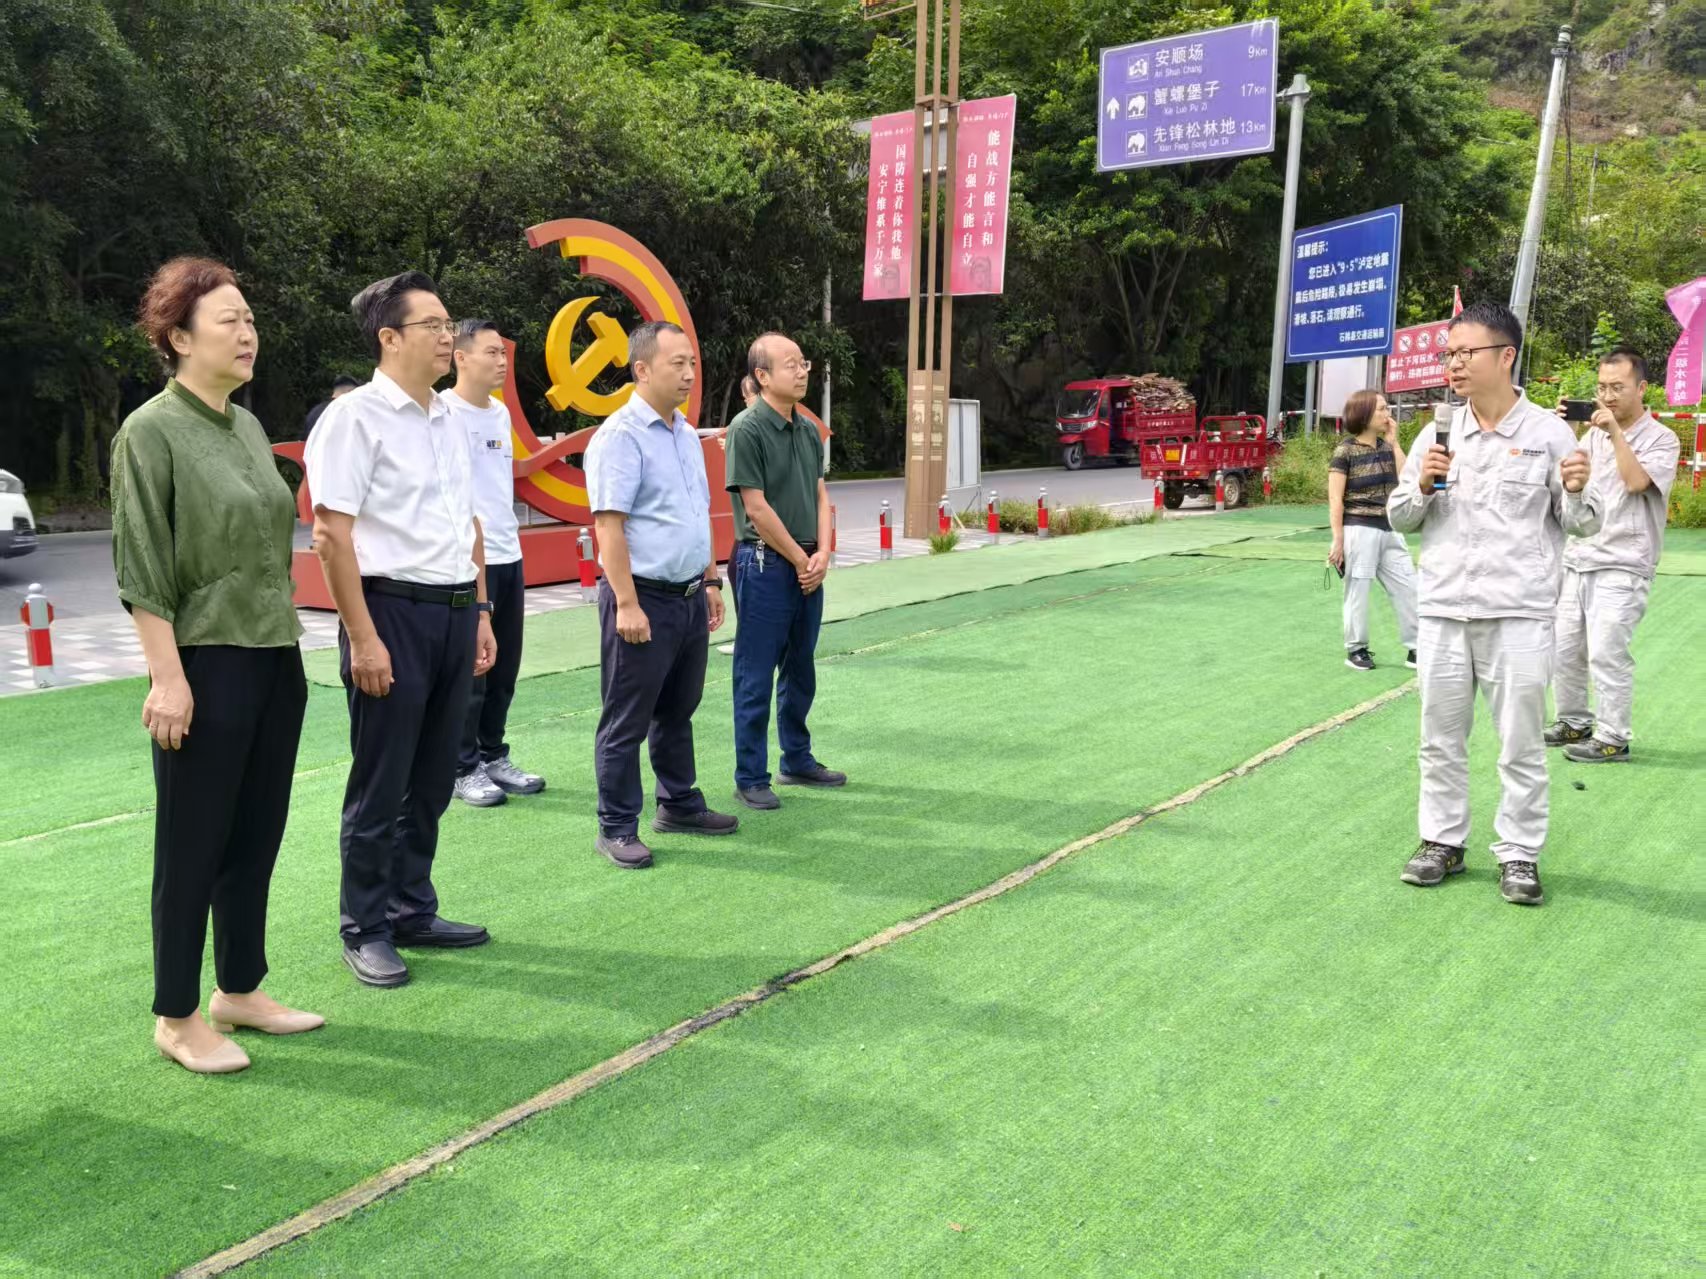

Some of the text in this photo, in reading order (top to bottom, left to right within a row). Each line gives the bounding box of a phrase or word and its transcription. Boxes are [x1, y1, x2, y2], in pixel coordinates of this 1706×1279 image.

[1155, 43, 1203, 67] 安顺场
[1248, 45, 1268, 58] 9Km
[1154, 80, 1220, 106] 蟹螺堡子
[1241, 83, 1267, 97] 17Km
[1153, 117, 1236, 144] 先锋松林地
[1240, 120, 1266, 134] 13Km
[981, 129, 1000, 246] 能战方能言和
[891, 143, 906, 260] 国防连着你我他
[962, 152, 977, 267] 自强才能自立
[873, 163, 888, 278] 安宁维系千万家
